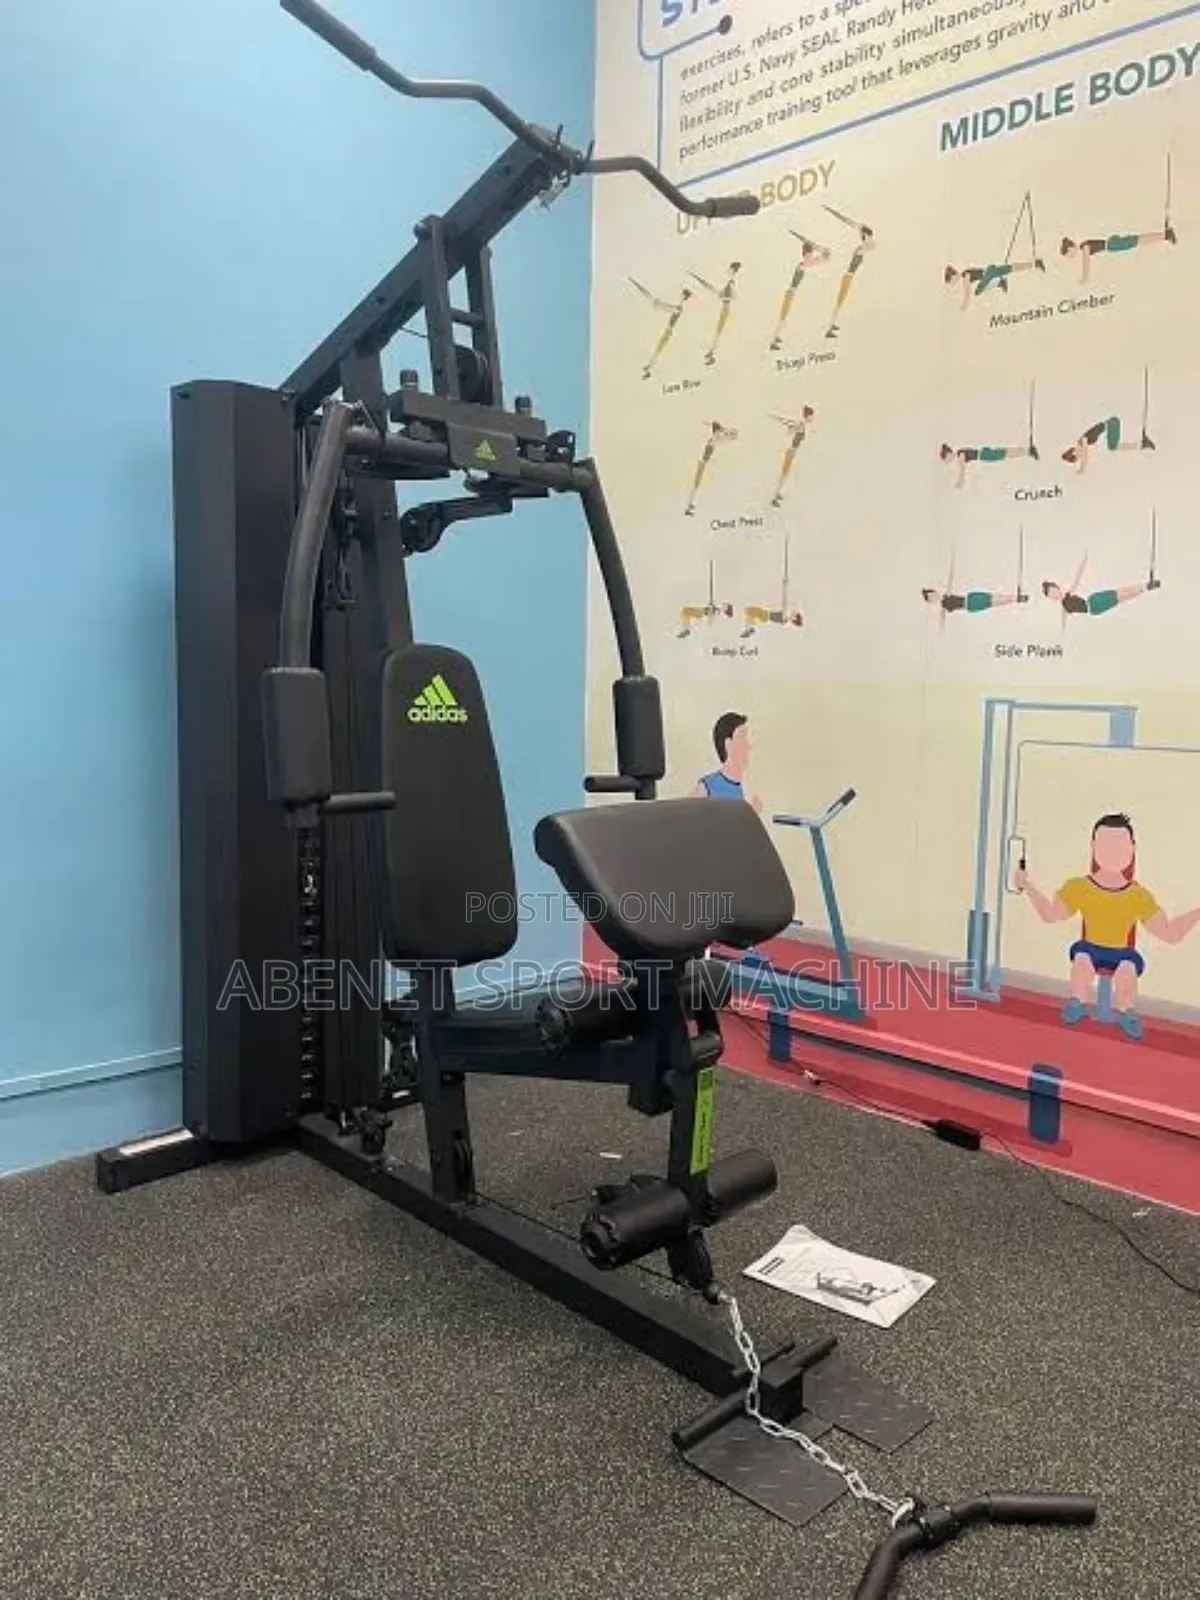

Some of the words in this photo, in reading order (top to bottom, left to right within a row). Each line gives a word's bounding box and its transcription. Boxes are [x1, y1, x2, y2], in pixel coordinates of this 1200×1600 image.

[728, 62, 756, 86] U.S.
[759, 50, 797, 73] Navy
[802, 27, 841, 57] SEAL
[847, 6, 897, 38] Randy
[752, 22, 793, 48] refers
[799, 14, 815, 30] to
[820, 7, 829, 20] a
[748, 80, 775, 106] and
[780, 70, 813, 93] core
[820, 41, 886, 78] stability
[892, 0, 1026, 48] simultaneou
[680, 117, 764, 163] performance
[767, 96, 823, 126] training
[826, 75, 859, 103] tool
[861, 67, 894, 91] that
[900, 35, 981, 76] leverages
[987, 11, 1053, 50] gravity
[939, 82, 1075, 152] MIDDLE
[1089, 41, 1200, 106] BODY
[760, 159, 836, 208] BODY
[989, 304, 1054, 328] Mountain
[1014, 484, 1063, 501] Crunch
[994, 643, 1023, 659] Side
[407, 704, 469, 723] adidas
